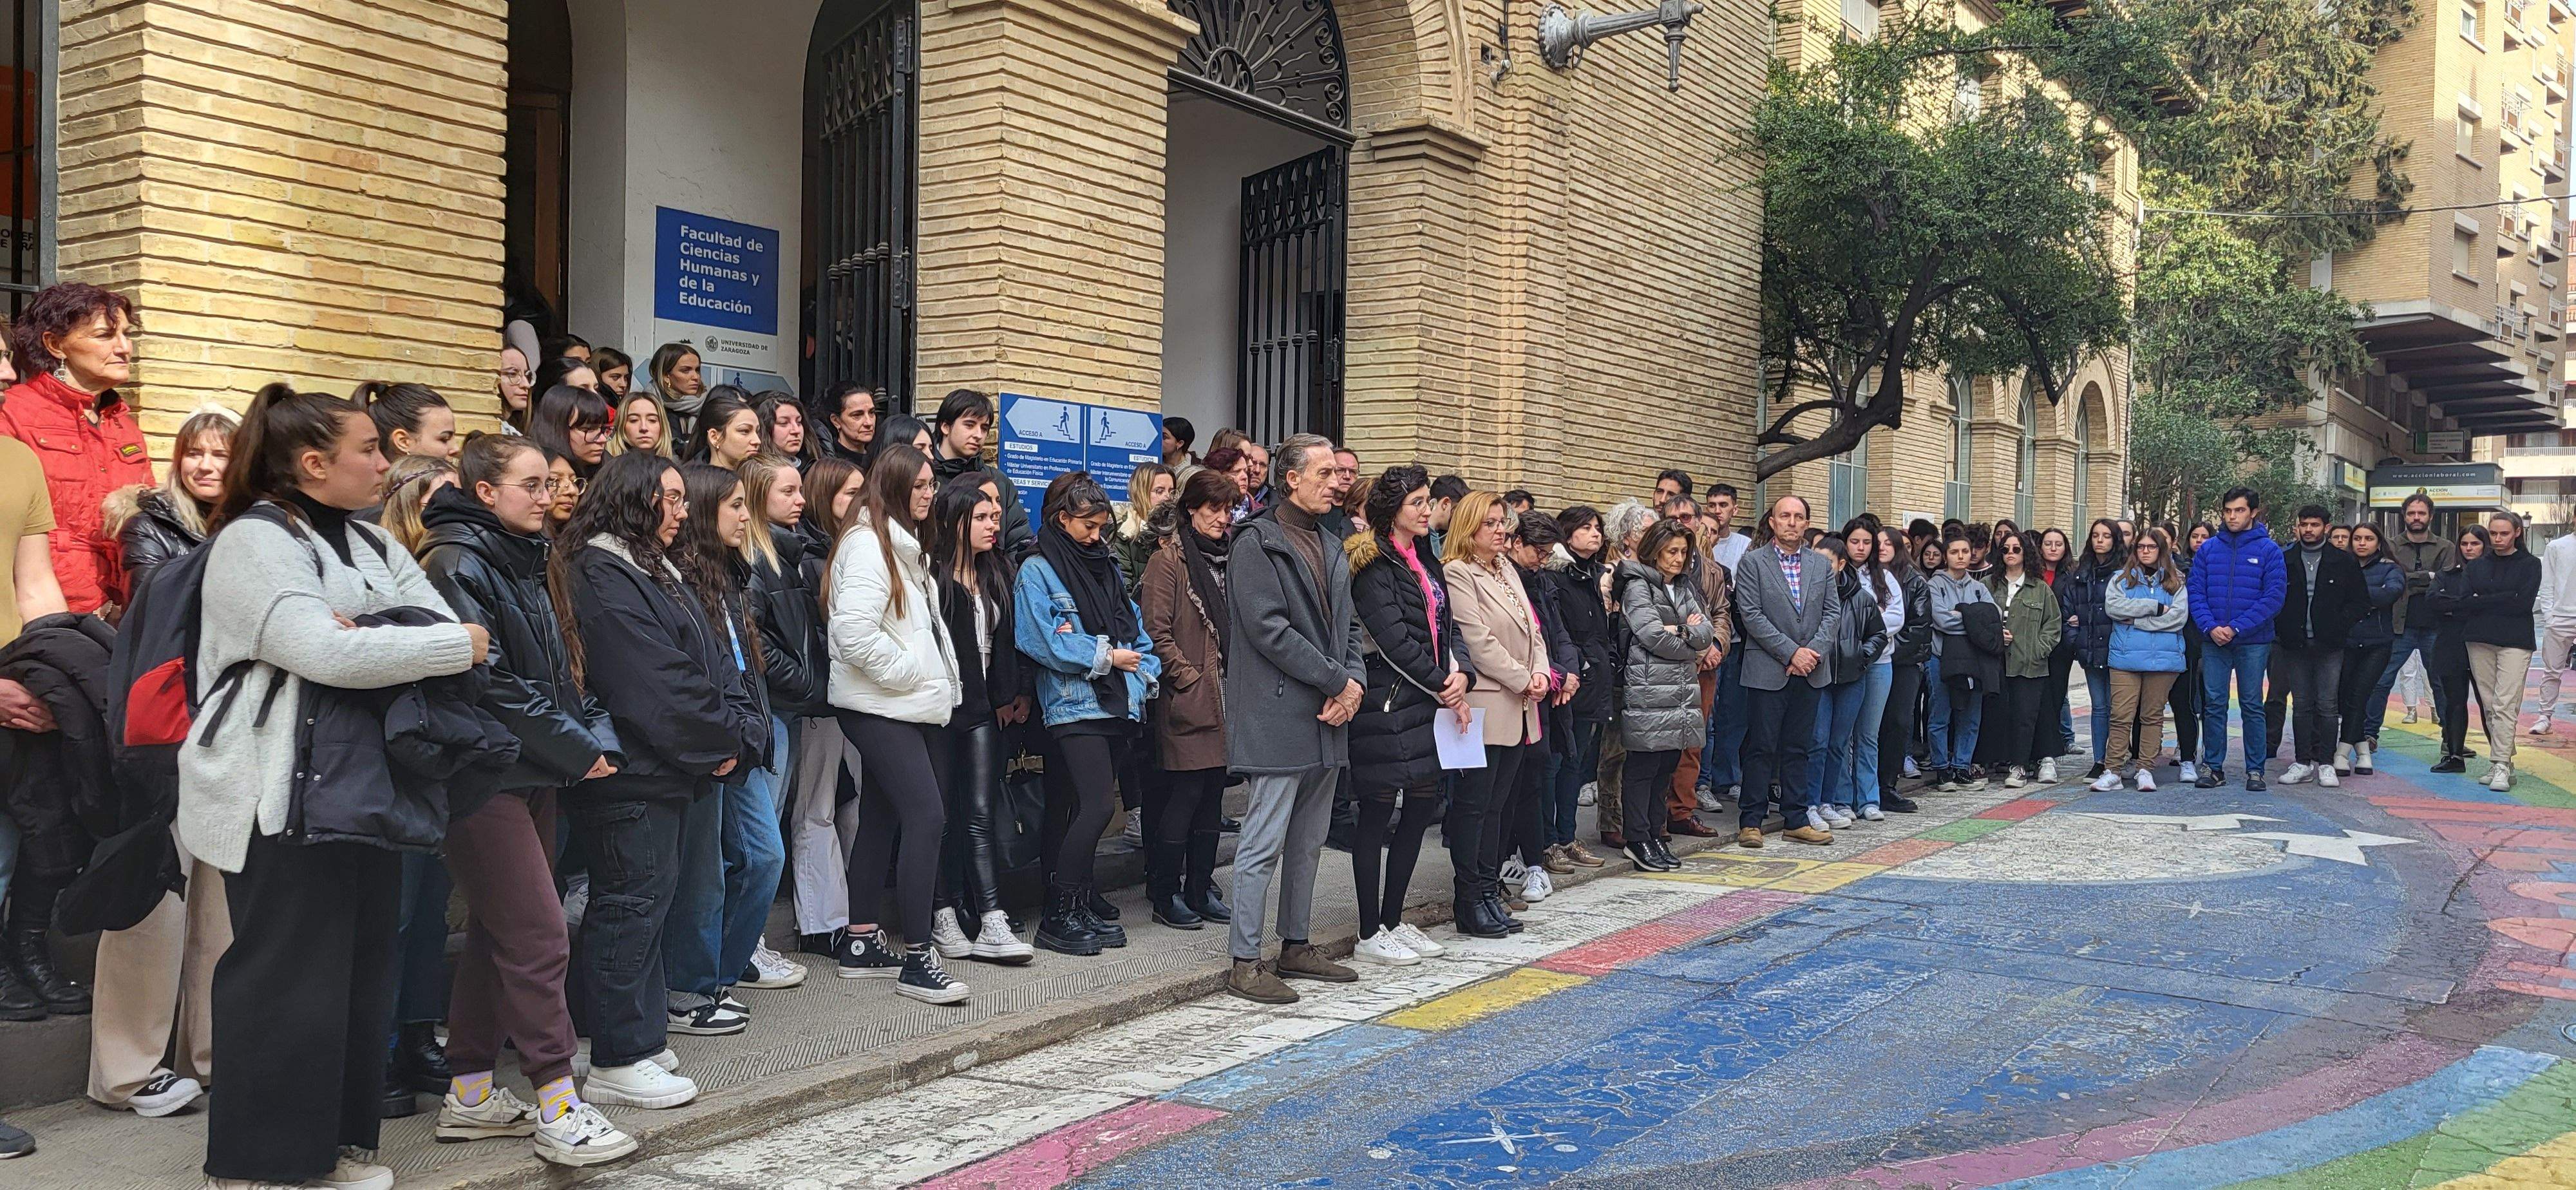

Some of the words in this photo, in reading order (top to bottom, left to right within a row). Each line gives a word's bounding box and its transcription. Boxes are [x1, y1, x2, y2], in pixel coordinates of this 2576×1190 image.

[681, 225, 741, 249] Facultad
[747, 238, 764, 252] de
[680, 241, 740, 264] Ciencias
[680, 258, 748, 282] Humanas
[752, 273, 760, 286] y
[679, 275, 697, 290] de
[702, 278, 715, 292] la
[679, 292, 752, 314] Educación
[721, 339, 760, 350] UNIVERSIDAD
[721, 346, 750, 355] ZARAGOZA
